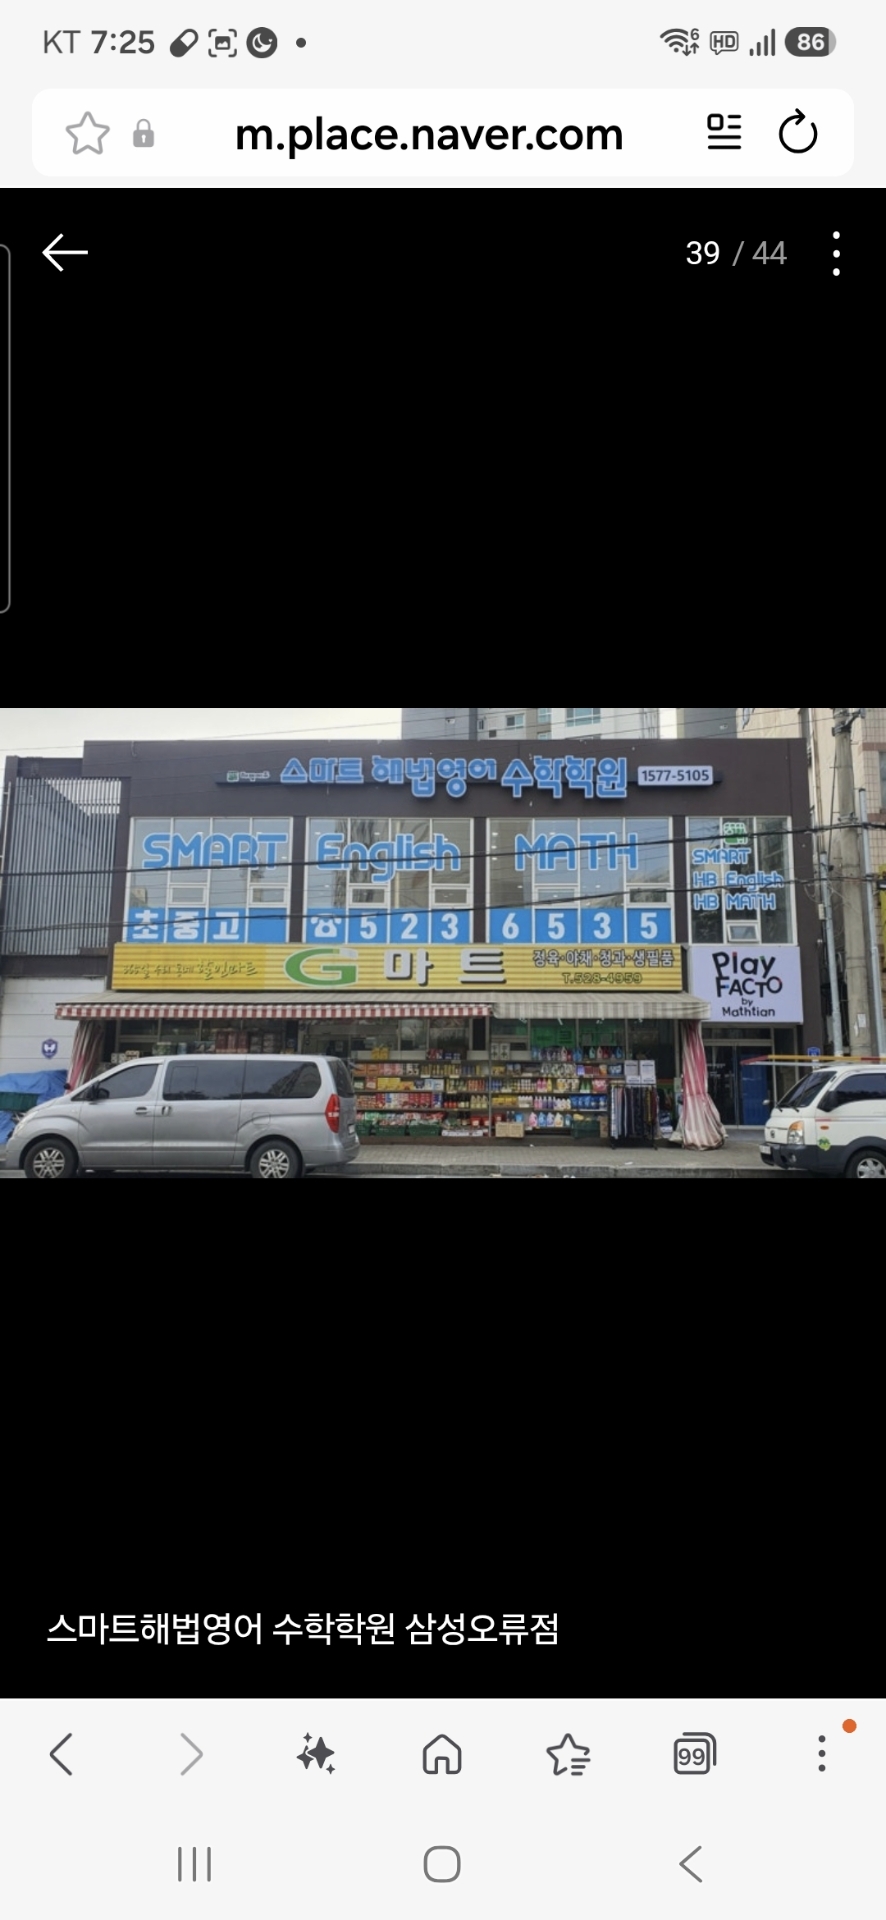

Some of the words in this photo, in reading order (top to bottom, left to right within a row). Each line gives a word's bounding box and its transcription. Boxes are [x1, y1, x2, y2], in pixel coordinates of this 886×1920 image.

[44, 30, 81, 53] KT
[92, 30, 154, 54] 7:25
[714, 35, 735, 47] HD
[797, 33, 826, 51] 86
[237, 116, 622, 159] m.place.naver.com
[687, 241, 719, 264] 39
[752, 241, 787, 264] 44
[280, 757, 364, 784] 스마트
[371, 755, 497, 798] 해법영어
[501, 755, 627, 799] 수학학원
[641, 769, 710, 783] 1577-5105
[142, 832, 289, 869] SMART
[316, 833, 461, 883] English
[514, 832, 639, 871] MATH
[692, 848, 751, 864] SMART
[693, 871, 718, 887] HB
[725, 871, 784, 892] English
[694, 893, 719, 910] HB
[726, 892, 776, 910] MATH
[132, 910, 241, 941] 초중고
[712, 951, 776, 979] Play
[562, 972, 643, 985] T.528-4959
[715, 976, 783, 998] FACTO
[722, 1006, 775, 1018] Mathtian
[741, 997, 753, 1007] by
[679, 1748, 705, 1765] 99
